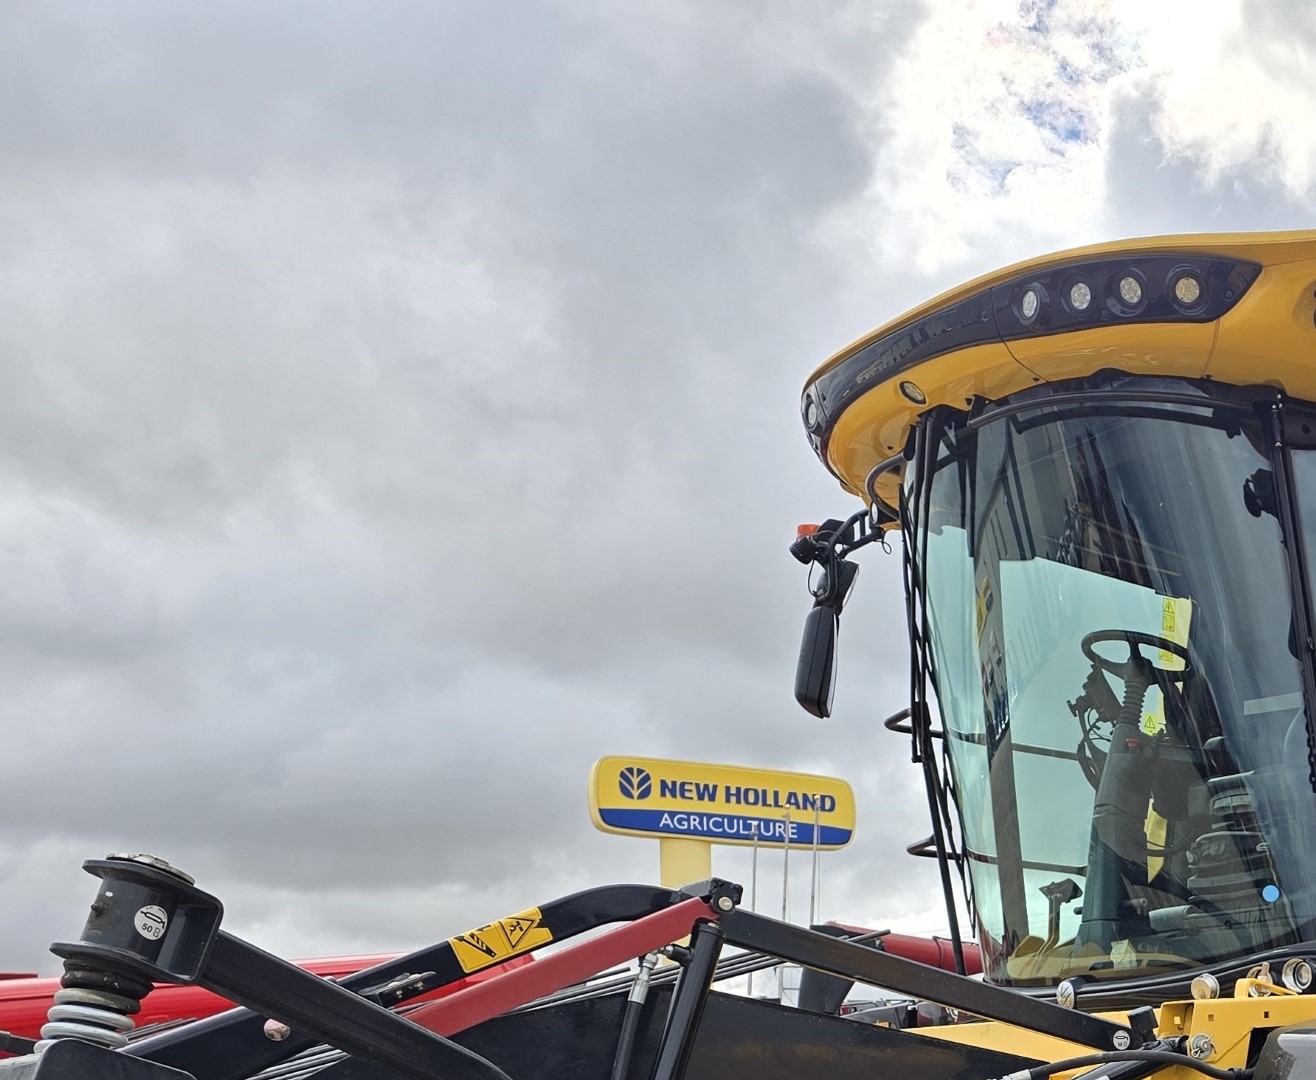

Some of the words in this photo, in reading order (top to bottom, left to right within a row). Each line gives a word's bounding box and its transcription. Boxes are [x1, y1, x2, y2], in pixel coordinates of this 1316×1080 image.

[660, 779, 718, 802] NEW
[725, 785, 836, 813] HOLLAND
[659, 813, 798, 839] AGRICULTURE
